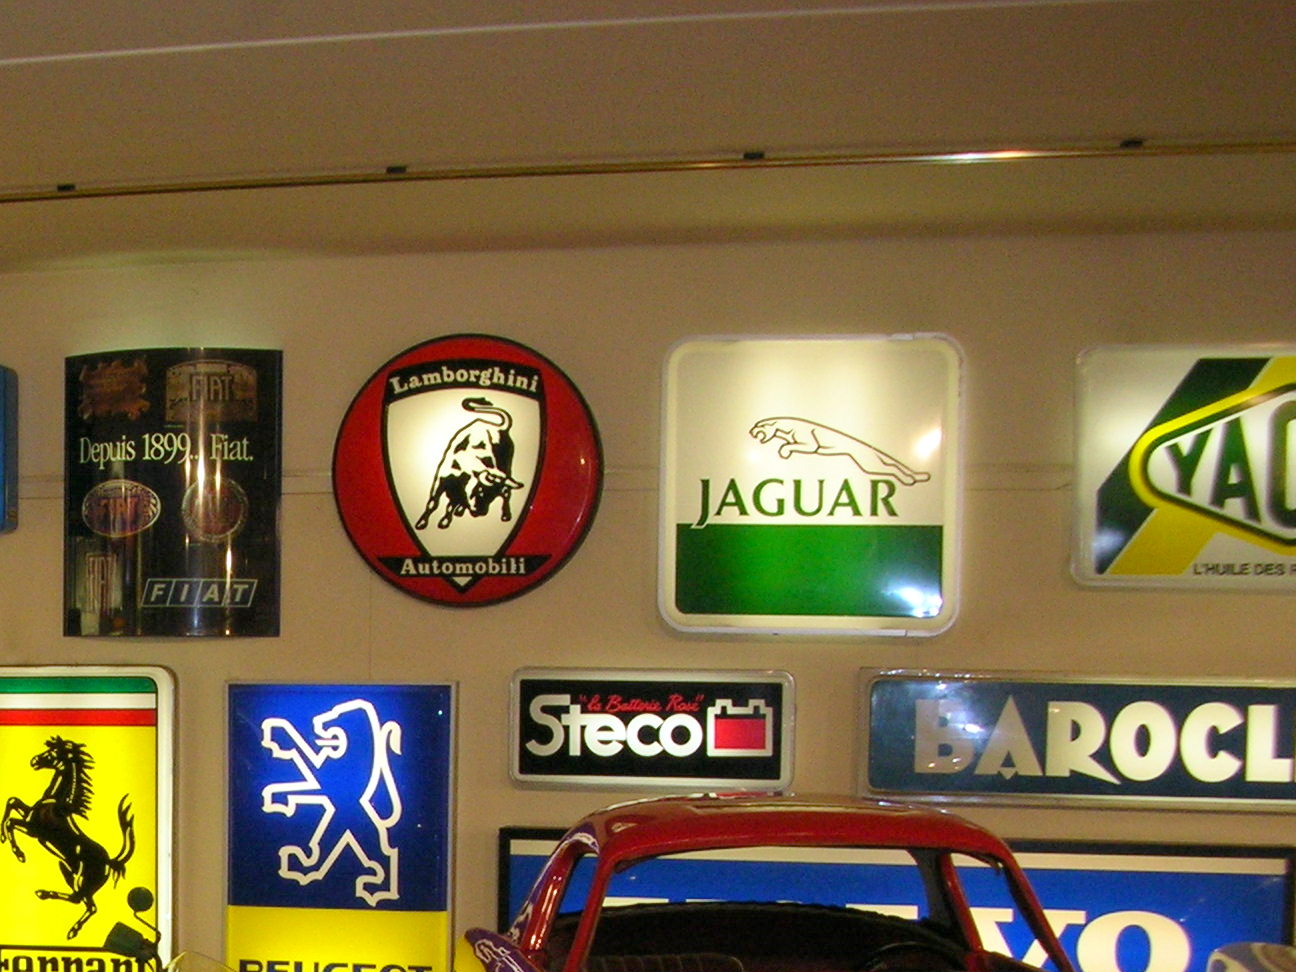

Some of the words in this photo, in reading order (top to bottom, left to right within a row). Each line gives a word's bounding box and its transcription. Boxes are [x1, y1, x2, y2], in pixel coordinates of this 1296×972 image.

[389, 366, 539, 395] Lamborghini
[79, 434, 136, 470] Depuis
[210, 433, 254, 462] Fiat.
[690, 477, 899, 529] JAGUAR
[400, 556, 526, 576] Automobili
[150, 583, 250, 602] FIAT
[525, 693, 704, 758] Steco
[913, 694, 1296, 785] BAROCL
